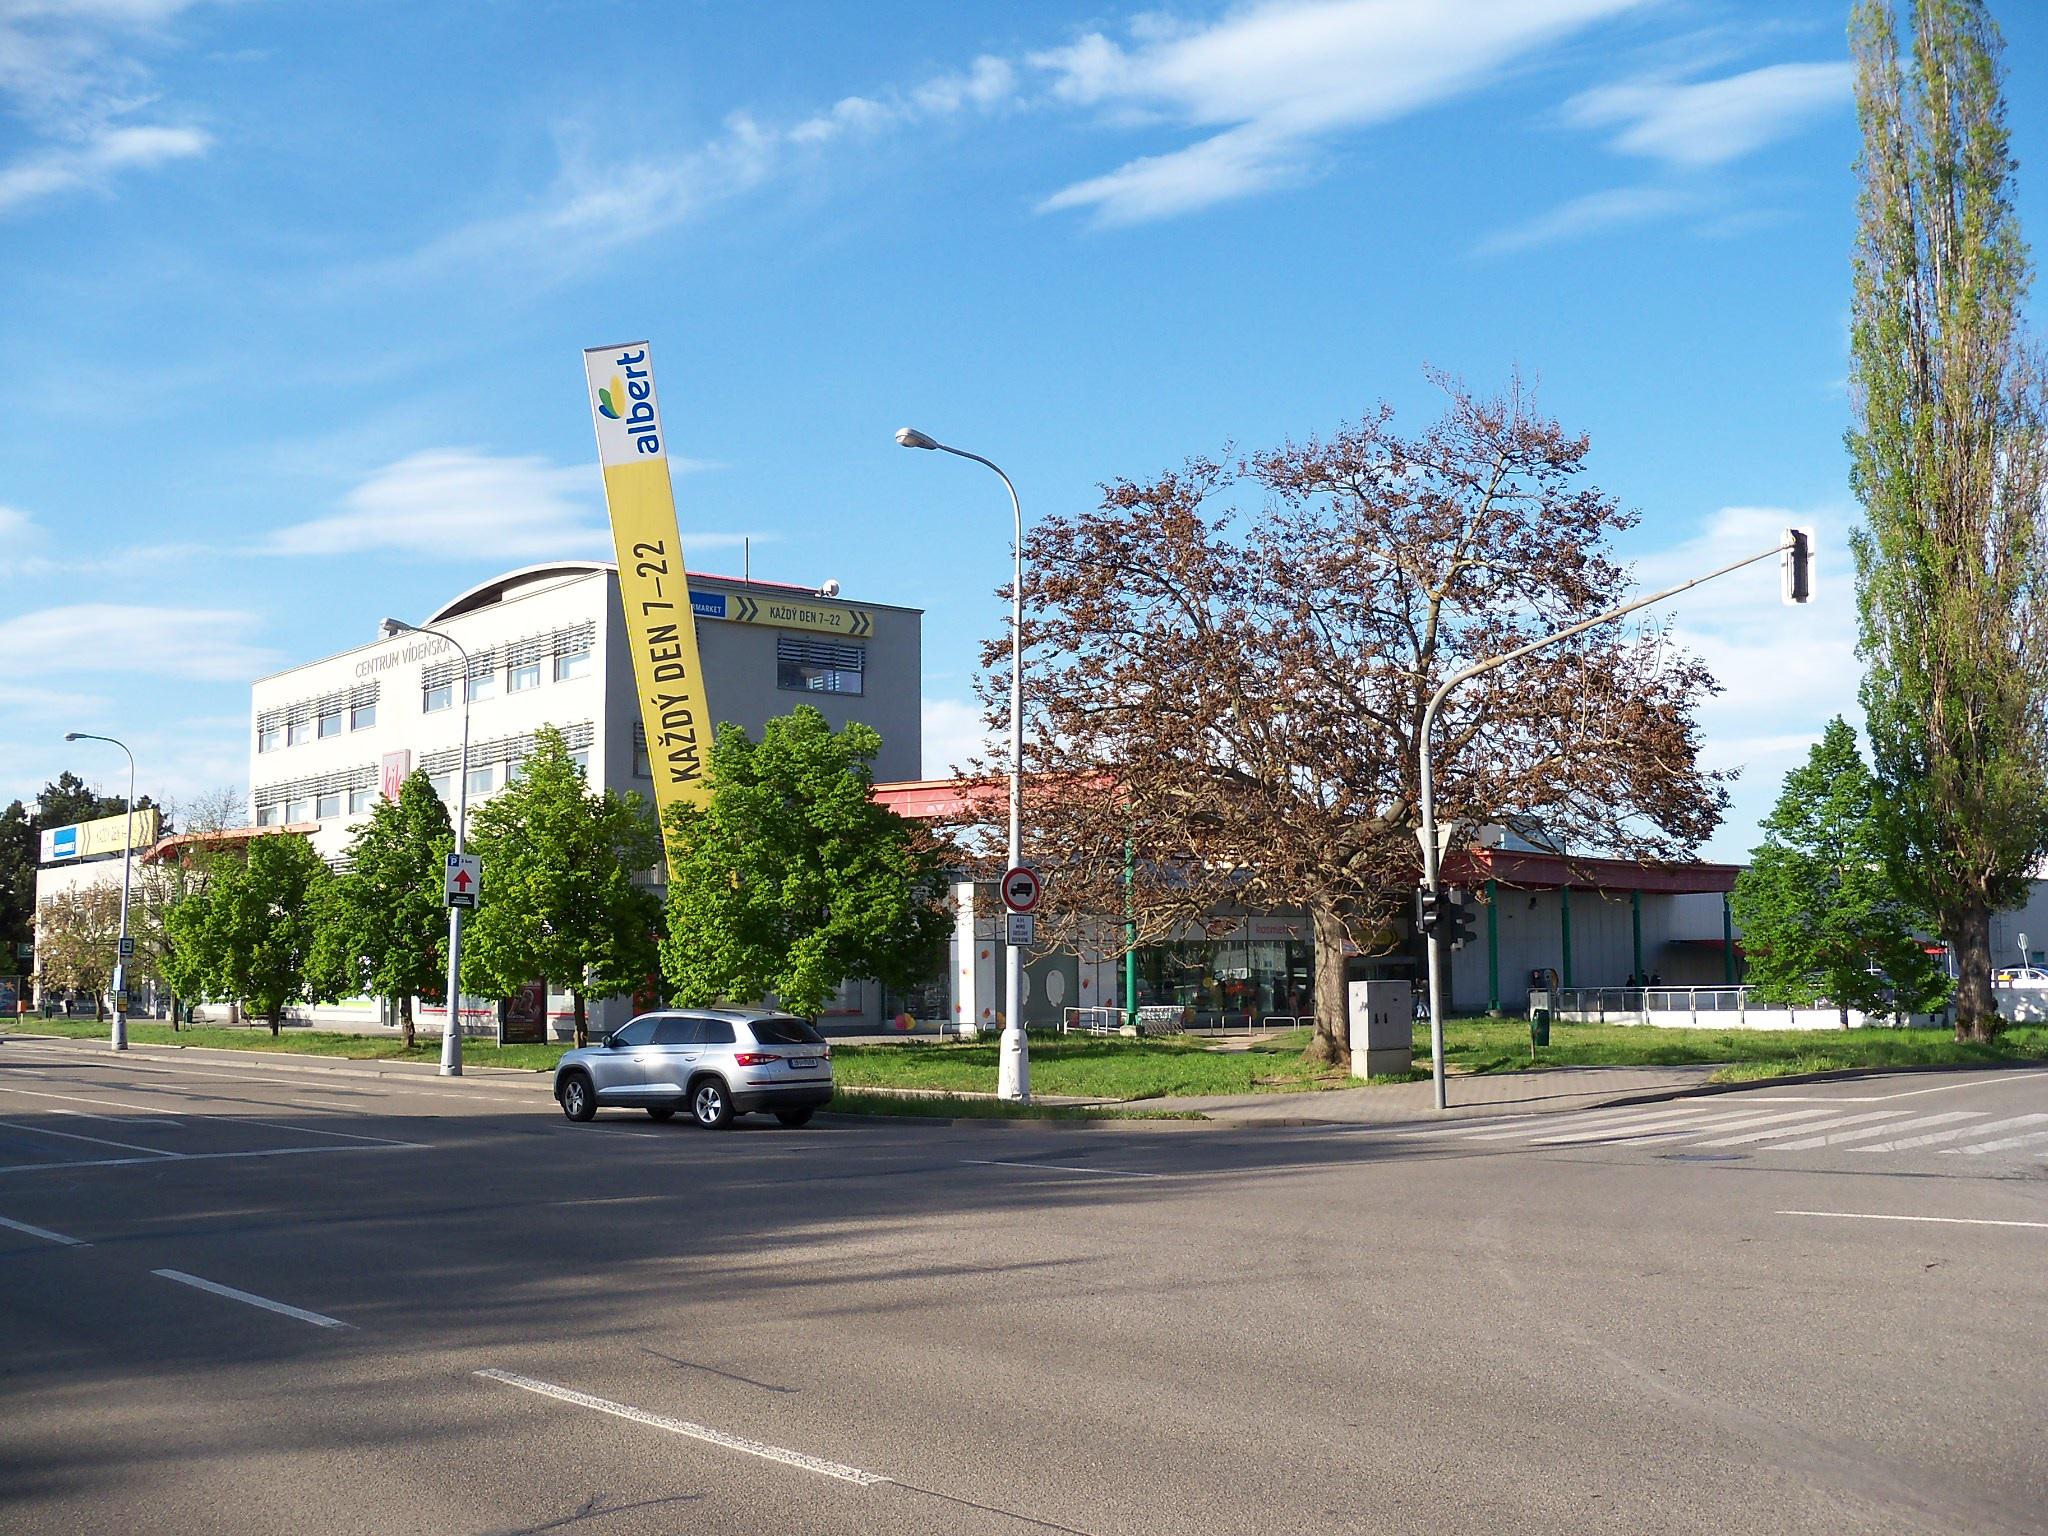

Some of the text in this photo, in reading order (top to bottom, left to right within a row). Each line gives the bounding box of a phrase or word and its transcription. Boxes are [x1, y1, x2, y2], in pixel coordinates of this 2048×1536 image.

[616, 349, 660, 455] albert
[770, 605, 797, 621] KAŽDÝ
[799, 611, 817, 623] DEN
[355, 630, 450, 678] CENTRUM VÍDEŇSKÁ
[647, 623, 685, 684] DEN
[650, 693, 702, 784] KAŽDÝ
